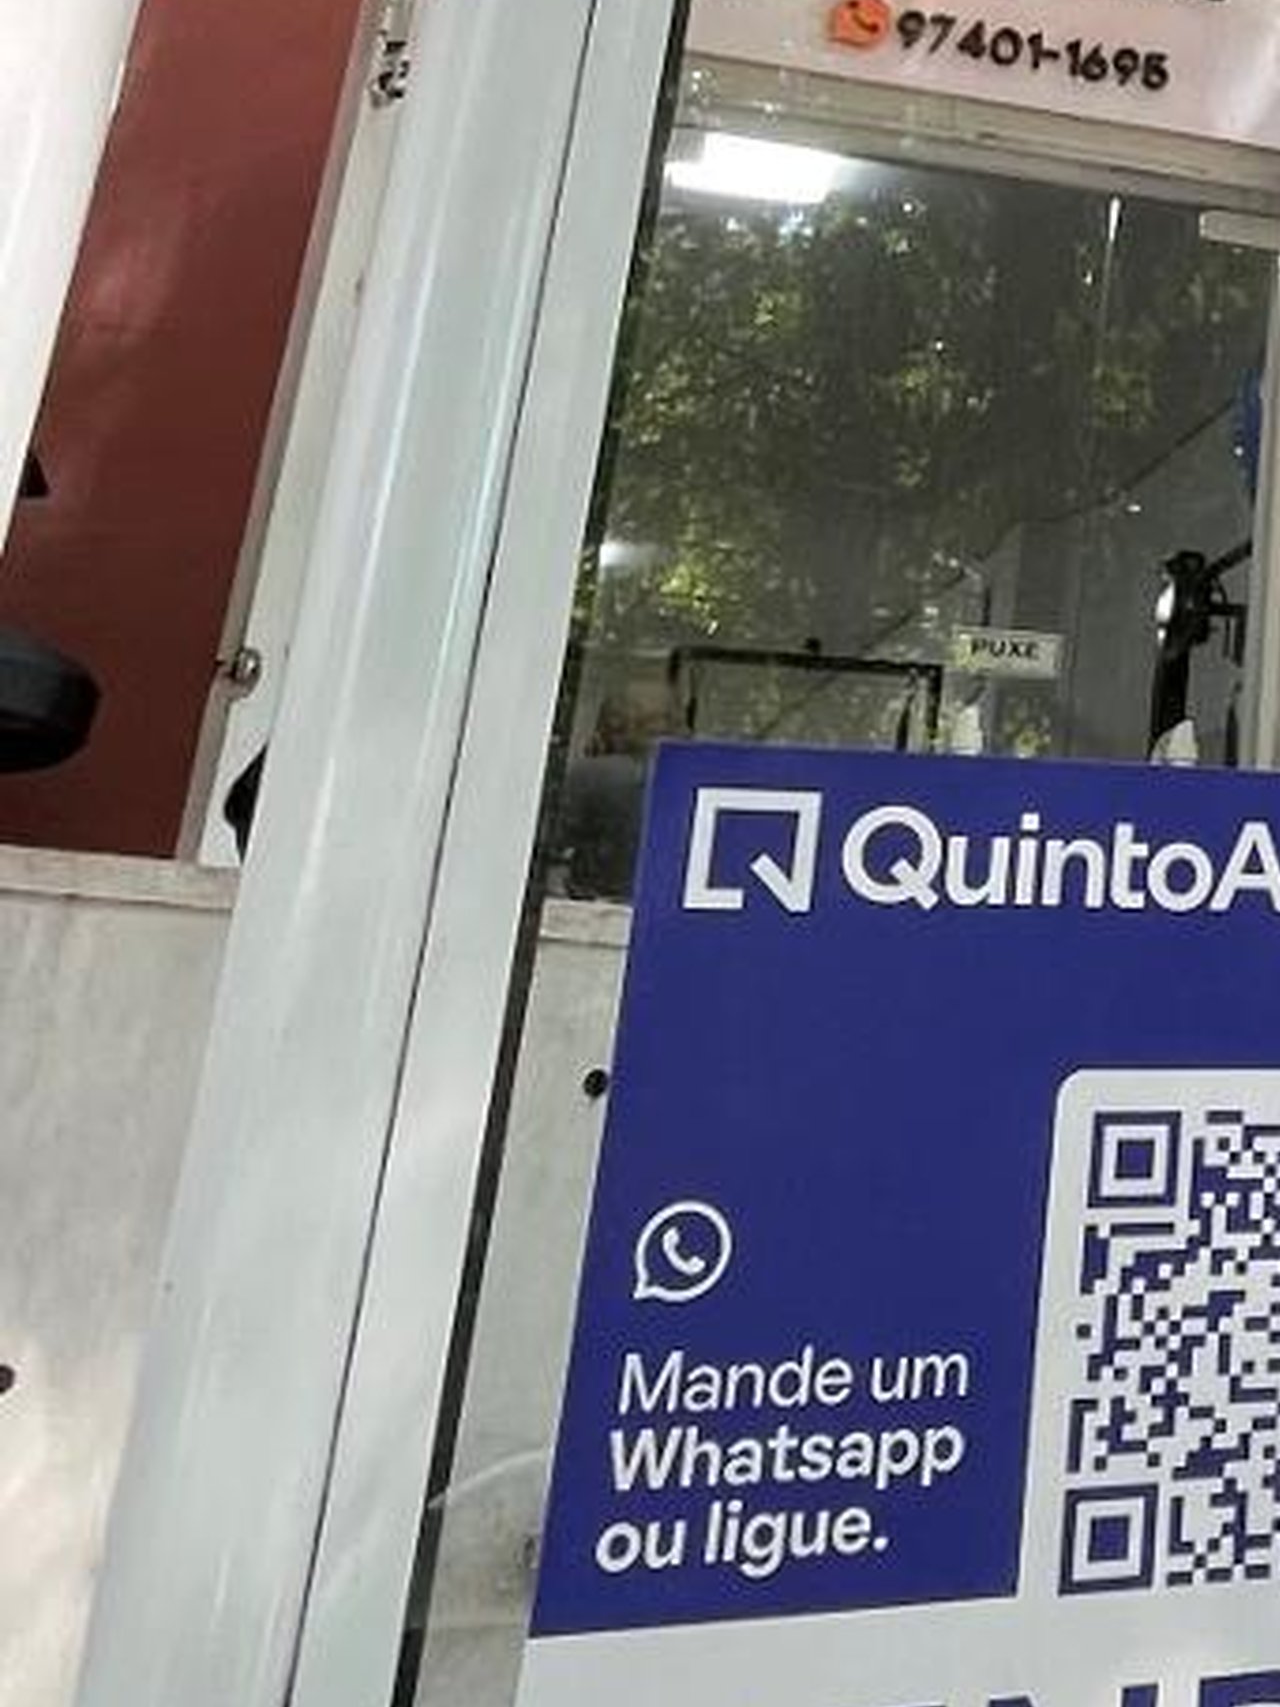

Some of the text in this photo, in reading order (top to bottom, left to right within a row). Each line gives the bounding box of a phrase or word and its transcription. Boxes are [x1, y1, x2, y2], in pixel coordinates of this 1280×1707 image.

[896, 9, 1170, 90] 97401-1695
[970, 638, 1040, 661] PUXE
[616, 1345, 970, 1417] Mande um
[607, 1418, 967, 1493] Whatsapp
[594, 1499, 889, 1577] ou ligue.
